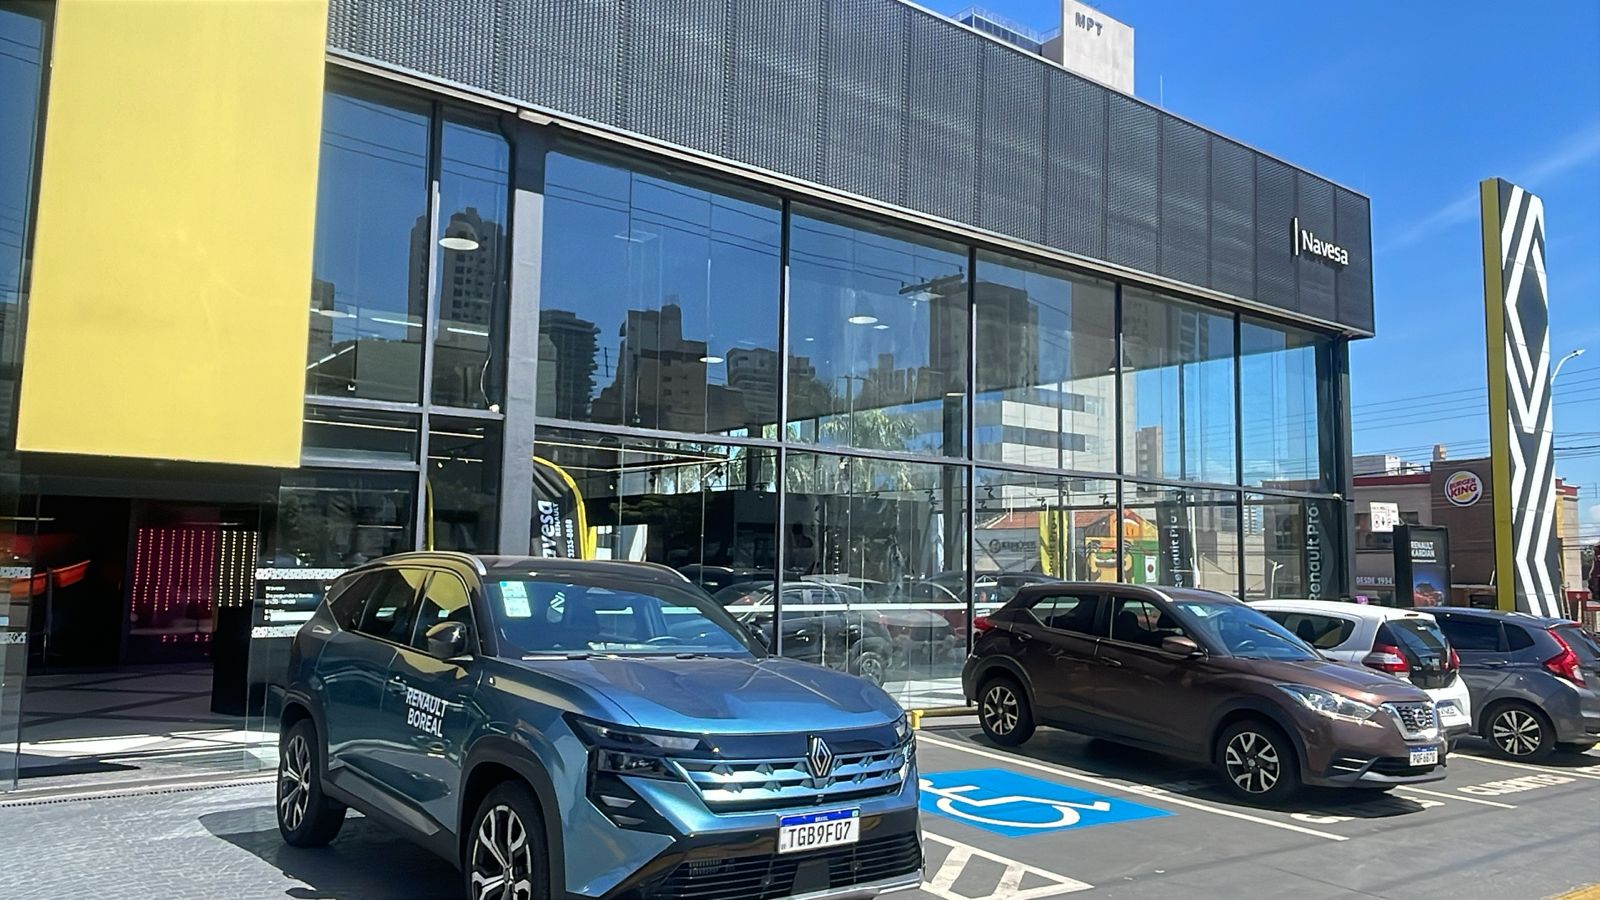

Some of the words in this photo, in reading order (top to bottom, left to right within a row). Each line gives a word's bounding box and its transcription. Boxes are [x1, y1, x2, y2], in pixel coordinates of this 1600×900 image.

[1075, 11, 1103, 37] MPT
[1301, 229, 1349, 266] Navesa
[1449, 477, 1476, 490] BURGER
[1450, 483, 1478, 497] KING
[538, 500, 556, 558] avesa
[553, 503, 561, 536] RENAULT
[1411, 541, 1434, 549] RENAULT
[1411, 549, 1436, 558] KARDIAN
[1356, 576, 1375, 585] DESDE
[406, 686, 449, 718] RENAULT
[407, 707, 443, 738] BOREAL
[789, 821, 851, 847] TGB9F07
